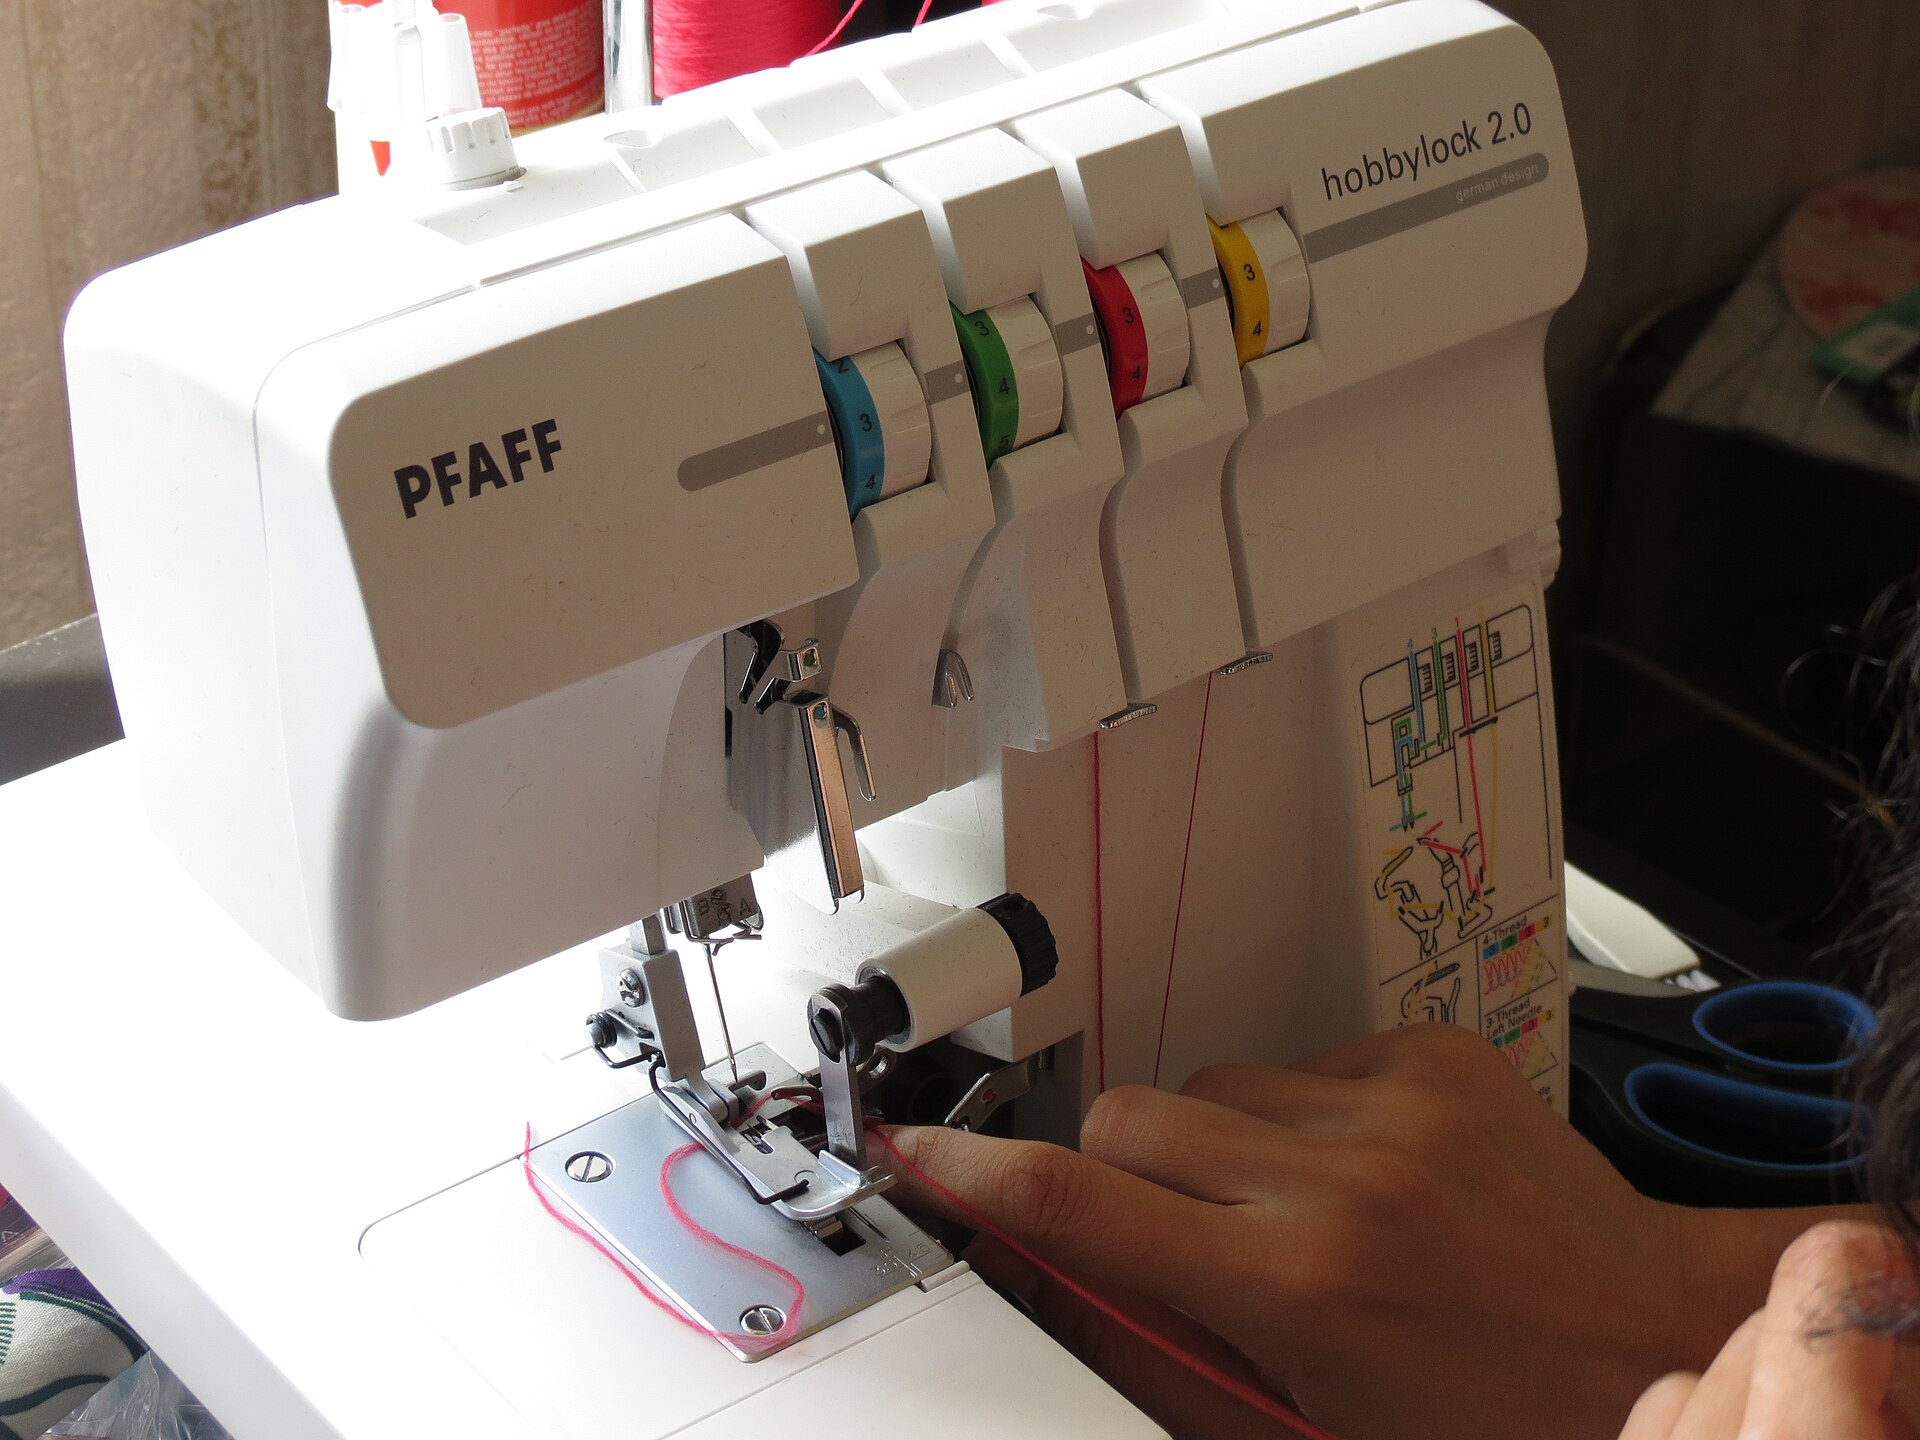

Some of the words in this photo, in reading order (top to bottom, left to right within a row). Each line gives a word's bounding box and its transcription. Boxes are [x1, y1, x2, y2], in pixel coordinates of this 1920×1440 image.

[1321, 120, 1482, 200] hobbylock
[1487, 102, 1532, 145] 2.0
[1455, 178, 1499, 203] german
[1500, 162, 1539, 187] design
[1243, 263, 1256, 281] 3
[1122, 306, 1135, 325] 3
[974, 320, 990, 337] 3
[1252, 320, 1263, 337] 4
[1131, 365, 1142, 381] 4
[999, 377, 1010, 395] 4
[859, 413, 873, 433] 3
[393, 418, 562, 519] PFAFF
[864, 473, 877, 490] 4
[1483, 914, 1527, 945] 4-Thread
[1486, 997, 1531, 1029] 3-Thread
[1487, 1023, 1505, 1040] Left
[1508, 1004, 1542, 1028] Needle
